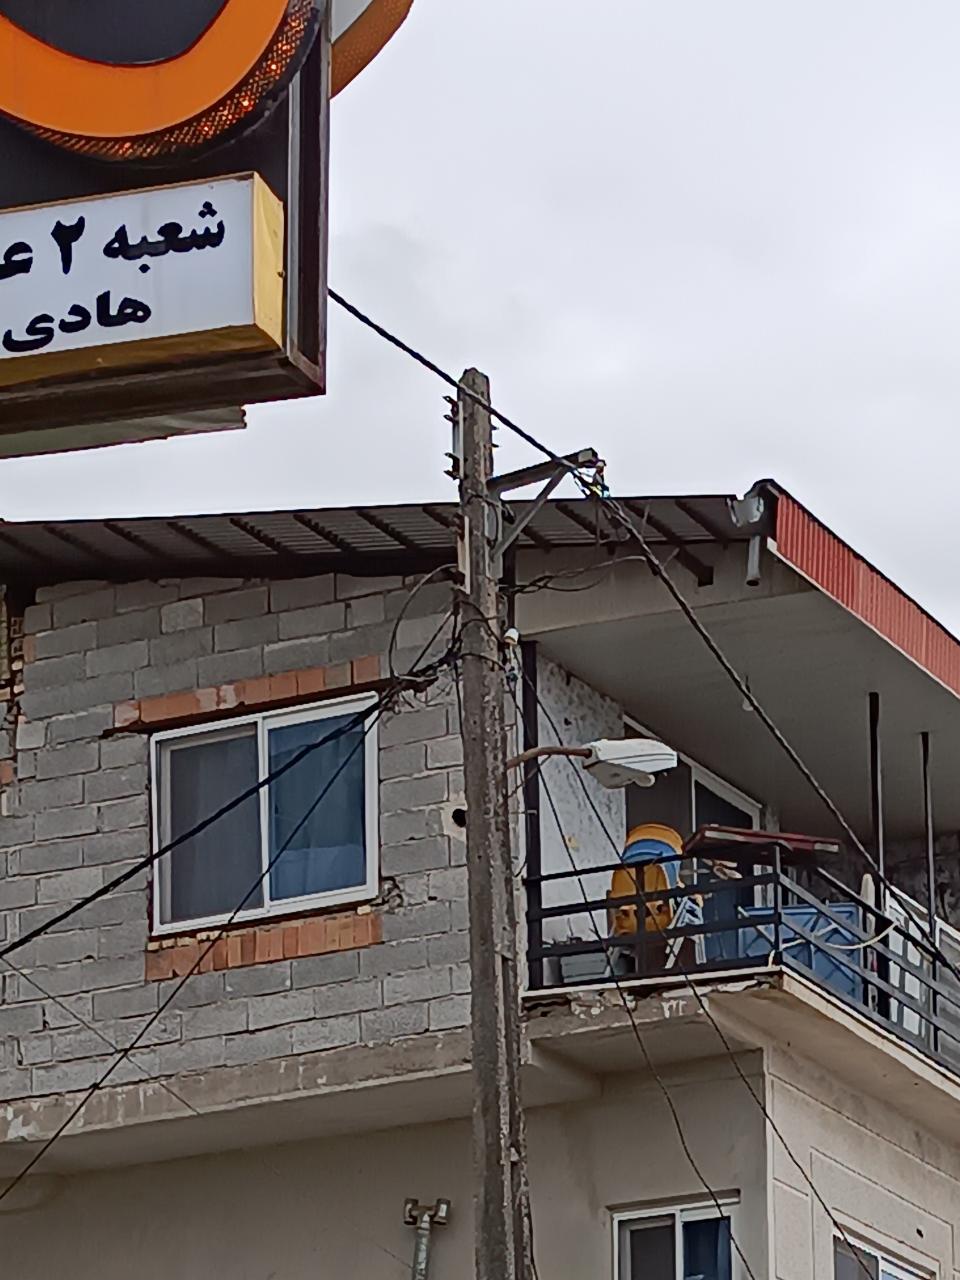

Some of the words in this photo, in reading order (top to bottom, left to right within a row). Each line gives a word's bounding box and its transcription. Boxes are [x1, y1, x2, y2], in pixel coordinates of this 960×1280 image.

[50, 215, 86, 275] ۲
[102, 200, 226, 274] شعبه
[1, 290, 152, 352] هادی
